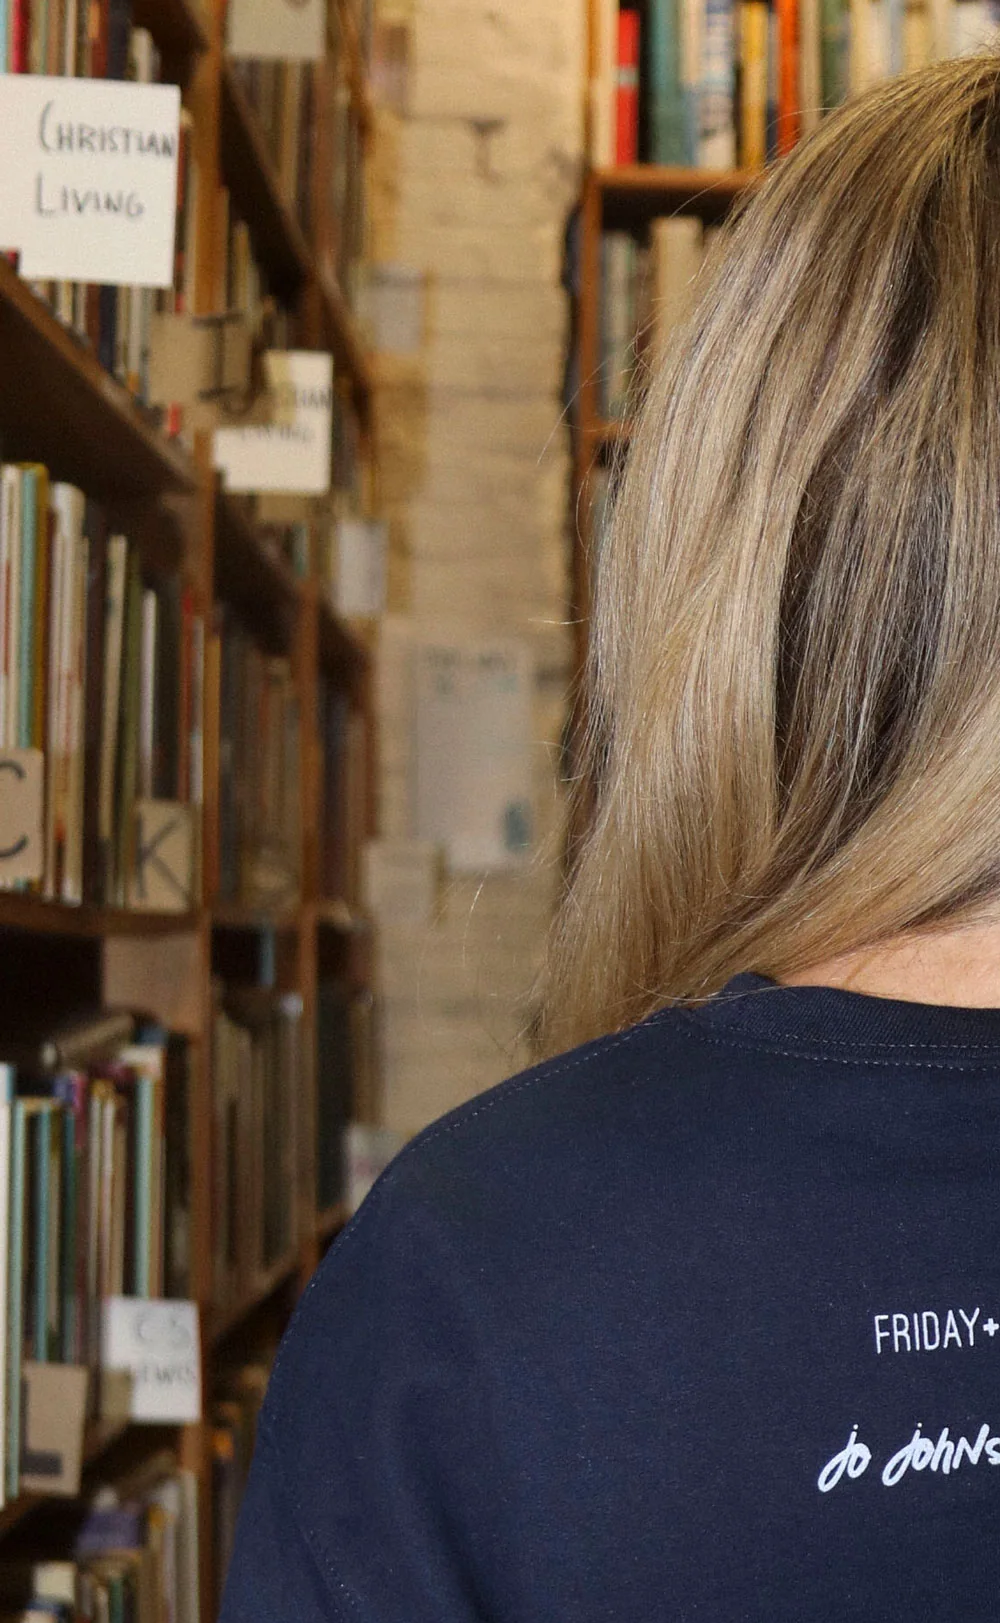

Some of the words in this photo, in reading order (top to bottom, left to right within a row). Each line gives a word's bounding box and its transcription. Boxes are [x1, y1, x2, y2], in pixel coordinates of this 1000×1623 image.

[38, 99, 176, 158] CHRISTIAN
[35, 170, 145, 218] LIVING
[134, 812, 188, 898] K
